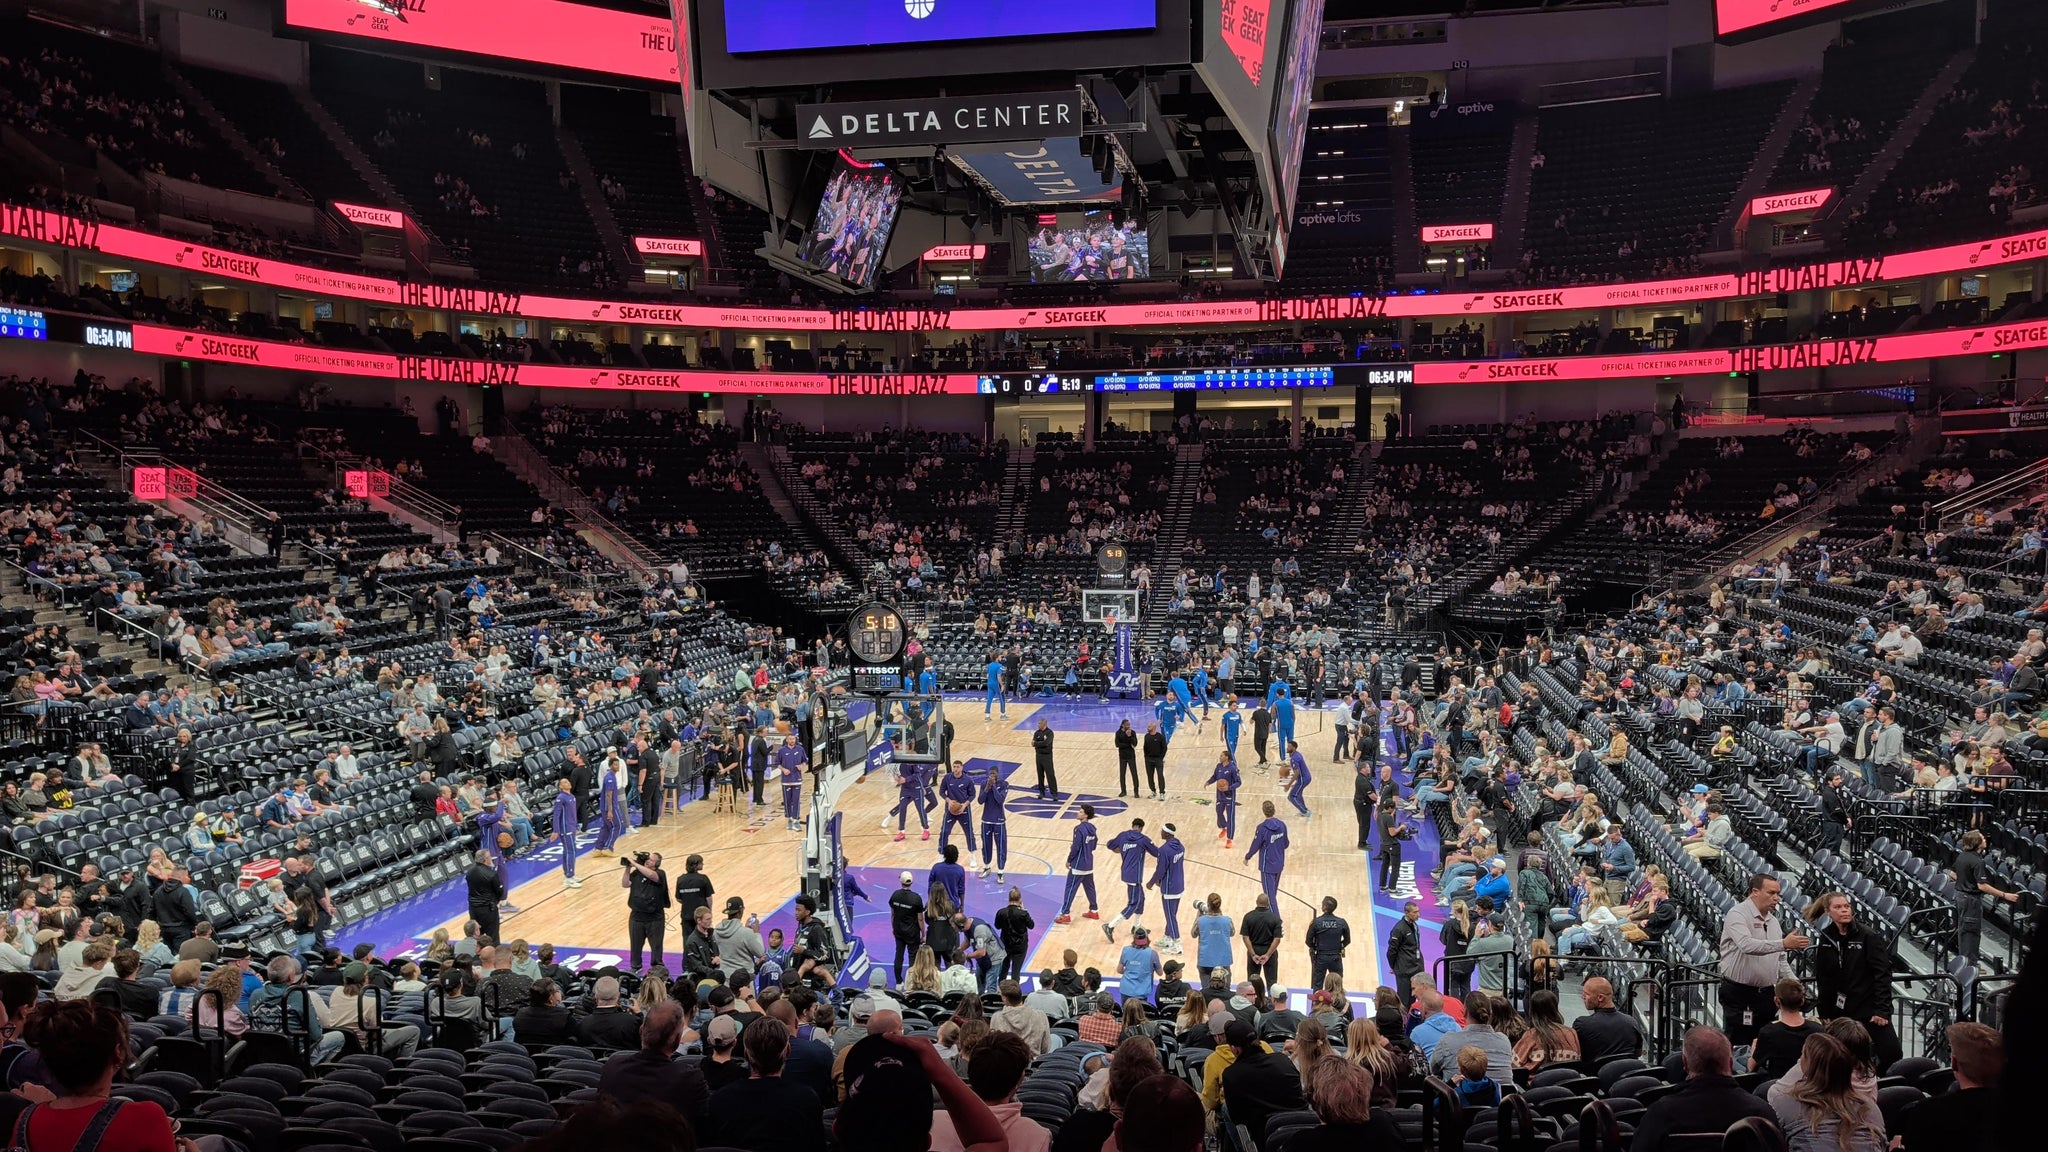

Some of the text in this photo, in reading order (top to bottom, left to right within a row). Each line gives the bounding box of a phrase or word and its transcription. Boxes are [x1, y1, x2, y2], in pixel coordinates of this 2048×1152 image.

[210, 8, 224, 18] KK
[372, 16, 388, 24] SEAT
[1242, 6, 1264, 28] SEAT
[371, 23, 389, 31] GEEK
[1240, 23, 1263, 46] GEEK
[640, 32, 665, 51] THE
[1458, 102, 1494, 116] aptive
[842, 104, 1070, 135] DELTA CENTER
[1765, 194, 1818, 210] SEATGEEK
[346, 208, 391, 223] SEATGEEK
[1299, 212, 1361, 227] aptive lofts
[52, 216, 100, 250] JAZZ
[1433, 227, 1481, 239] SEATGEEK
[646, 240, 690, 252] SEATGEEK
[2001, 238, 2048, 258] SEATG
[202, 250, 261, 278] SEATGEEK
[294, 273, 395, 295] OFFICIAL TICKETING PARTNER OF
[1734, 257, 1885, 296] THE UTAH JAZZ
[398, 281, 521, 315] THE UTAH JAZZ
[1606, 282, 1730, 299] OFFICIAL TICKETING PARTNER OF
[1256, 296, 1387, 320] THE UTAH JAZZ
[1494, 291, 1564, 309] SEATGEEK
[18, 317, 23, 325] 0
[619, 306, 683, 322] SEATGEEK
[830, 310, 950, 330] THE UTAH JAZZ
[1044, 310, 1107, 324] SEATGEEK
[1176, 309, 1211, 317] TICKETING
[18, 327, 39, 338] 0 0
[86, 326, 132, 348] 06:54 PM
[1994, 326, 2048, 347] SEATGE
[202, 338, 260, 361] SEATGEEK
[1728, 338, 1877, 371] THE UTAH JAZZ
[294, 354, 320, 364] OFFICIAL
[322, 357, 355, 368] TICKETING
[356, 360, 385, 370] PARTNER
[1488, 362, 1558, 378] SEATGEEK
[1601, 358, 1724, 371] OFFICIAL TICKETING PARTNER OF
[396, 356, 520, 385] THE UTAH JAZZ
[1369, 370, 1412, 384] 06:54 PM
[617, 373, 680, 388] SEATGEEK
[828, 375, 948, 394] THE UTAH JAZZ
[1003, 380, 1010, 391] 0
[1025, 380, 1032, 391] 0
[1062, 378, 1080, 390] 5:13
[2021, 412, 2045, 420] HEALTH
[141, 473, 160, 483] SEAT
[350, 476, 362, 484] SEAT
[140, 483, 160, 493] GEEK
[866, 615, 895, 629] 5:13
[837, 886, 851, 934] AMERICA
[771, 972, 778, 980] 19
